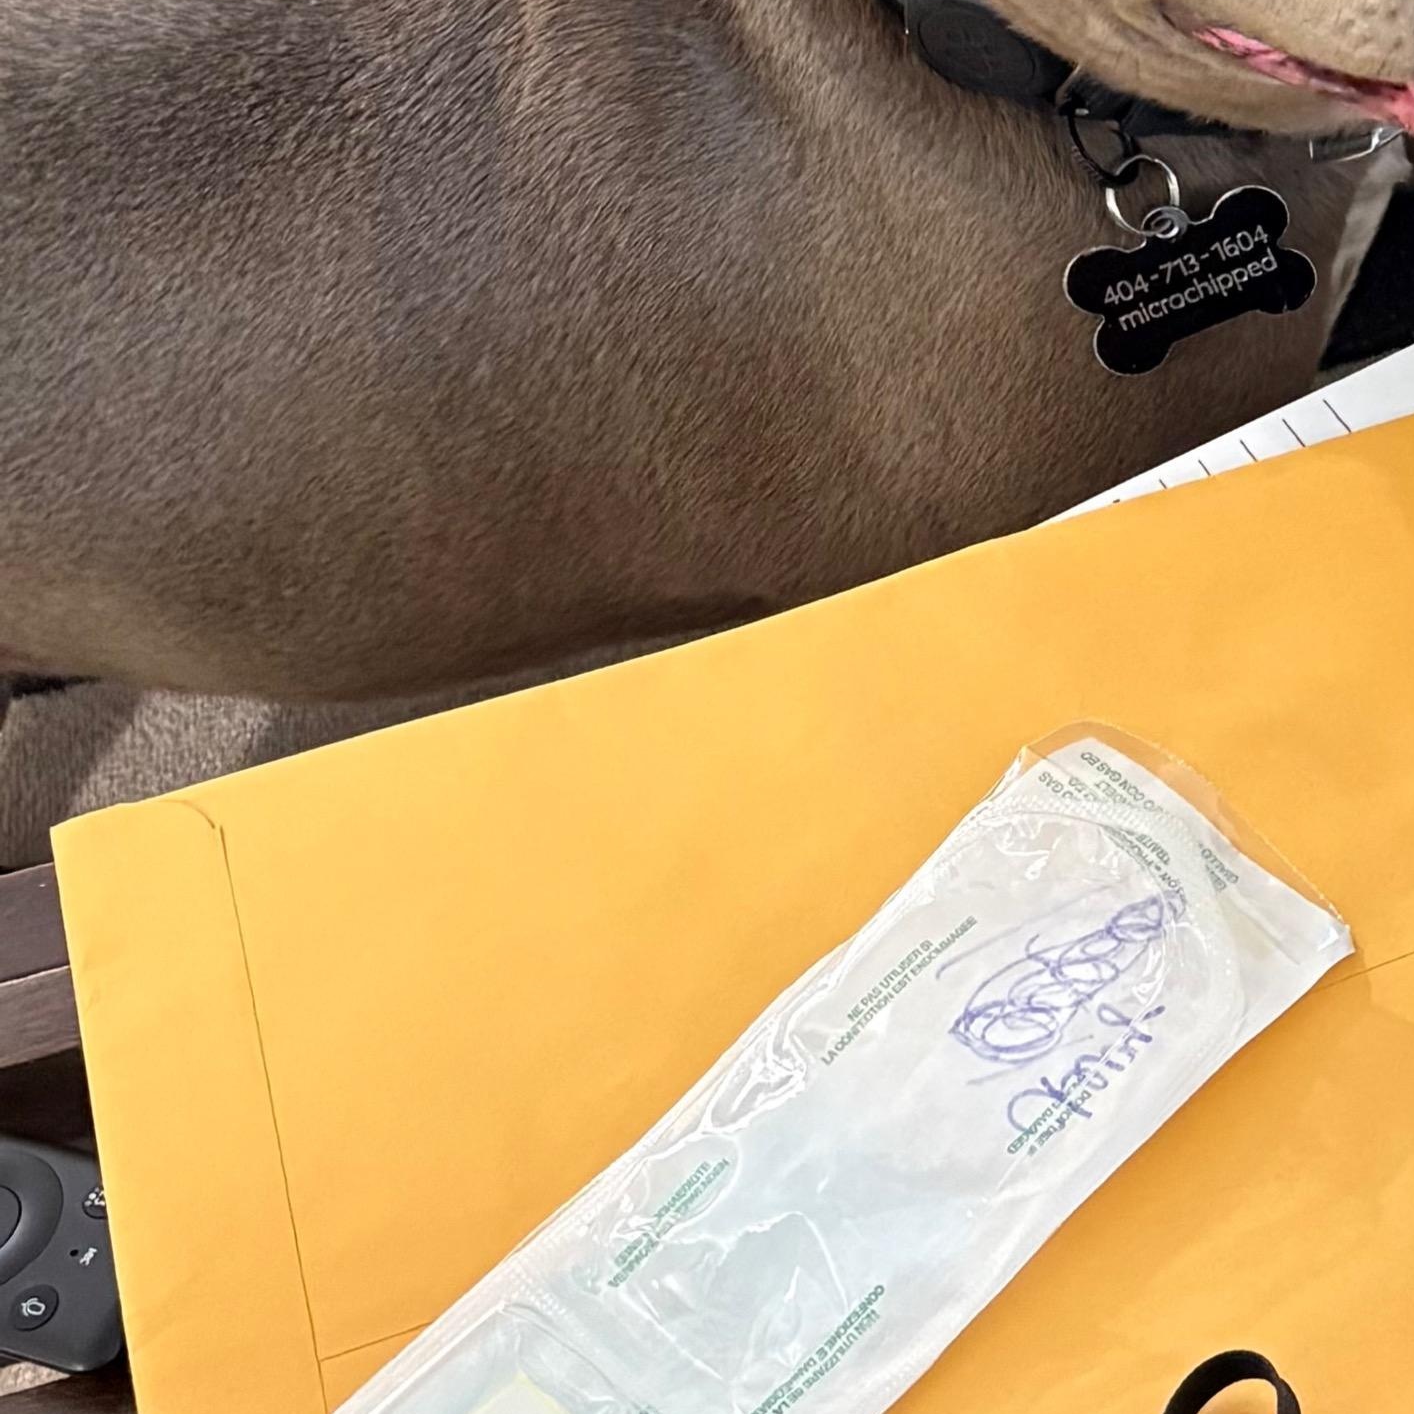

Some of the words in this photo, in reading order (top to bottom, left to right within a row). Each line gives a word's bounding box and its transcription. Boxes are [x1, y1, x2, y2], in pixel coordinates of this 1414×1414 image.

[1103, 224, 1269, 306] 404-713-1604
[1119, 247, 1278, 332] microchipped
[1077, 747, 1101, 769] EO
[1094, 759, 1123, 785] GAS
[819, 1046, 840, 1067] LA
[889, 972, 913, 995] EST
[858, 984, 883, 1009] PAS
[1004, 1105, 1054, 1157] DAMAGED
